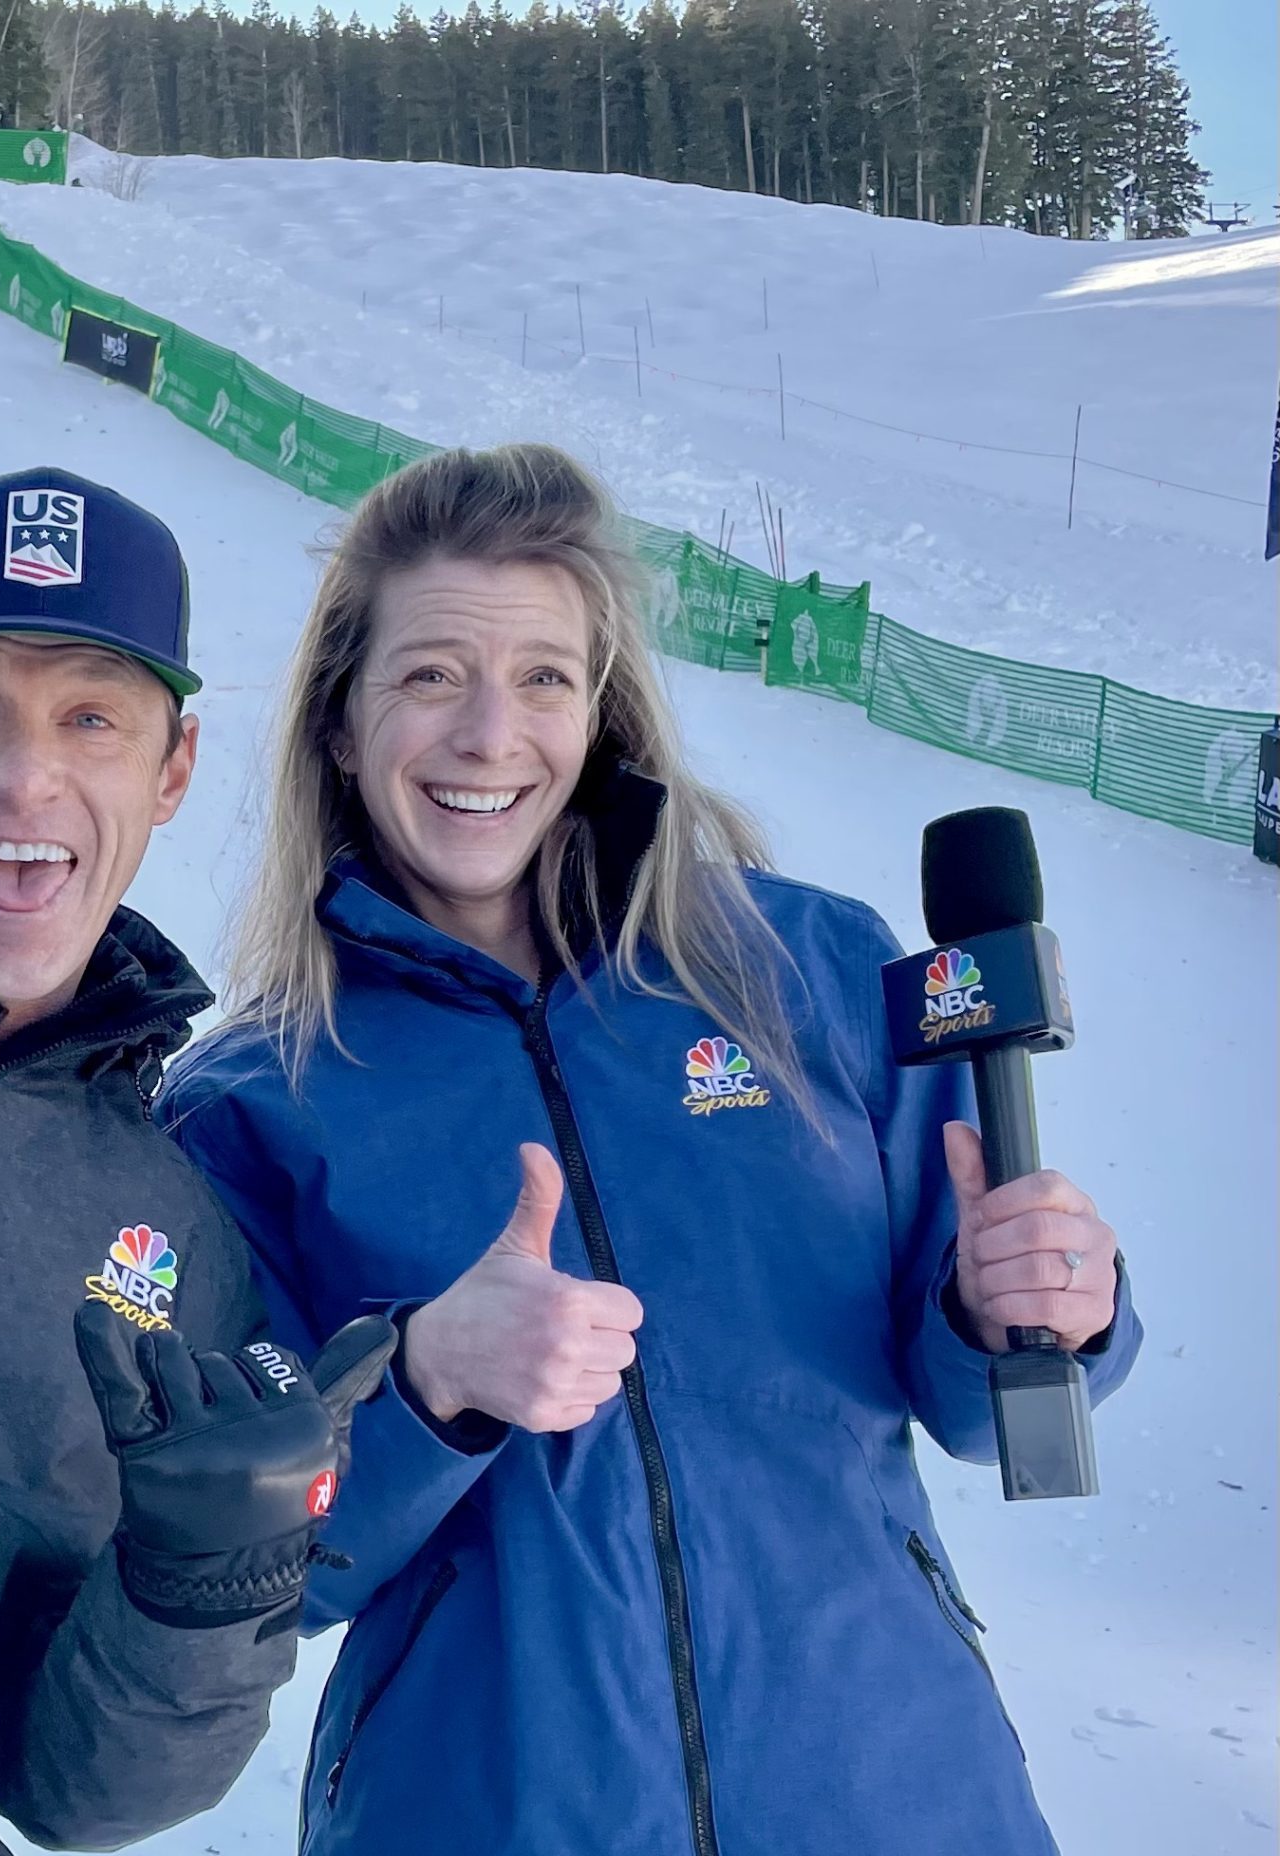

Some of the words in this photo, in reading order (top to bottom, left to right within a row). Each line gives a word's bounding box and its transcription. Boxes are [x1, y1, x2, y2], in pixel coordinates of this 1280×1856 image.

[13, 494, 78, 525] US
[826, 637, 856, 661] DEER
[925, 983, 987, 1018] NBC
[918, 1003, 996, 1045] Sports
[687, 1072, 761, 1097] NBC
[682, 1089, 772, 1117] Sports
[102, 1258, 173, 1319] NBC
